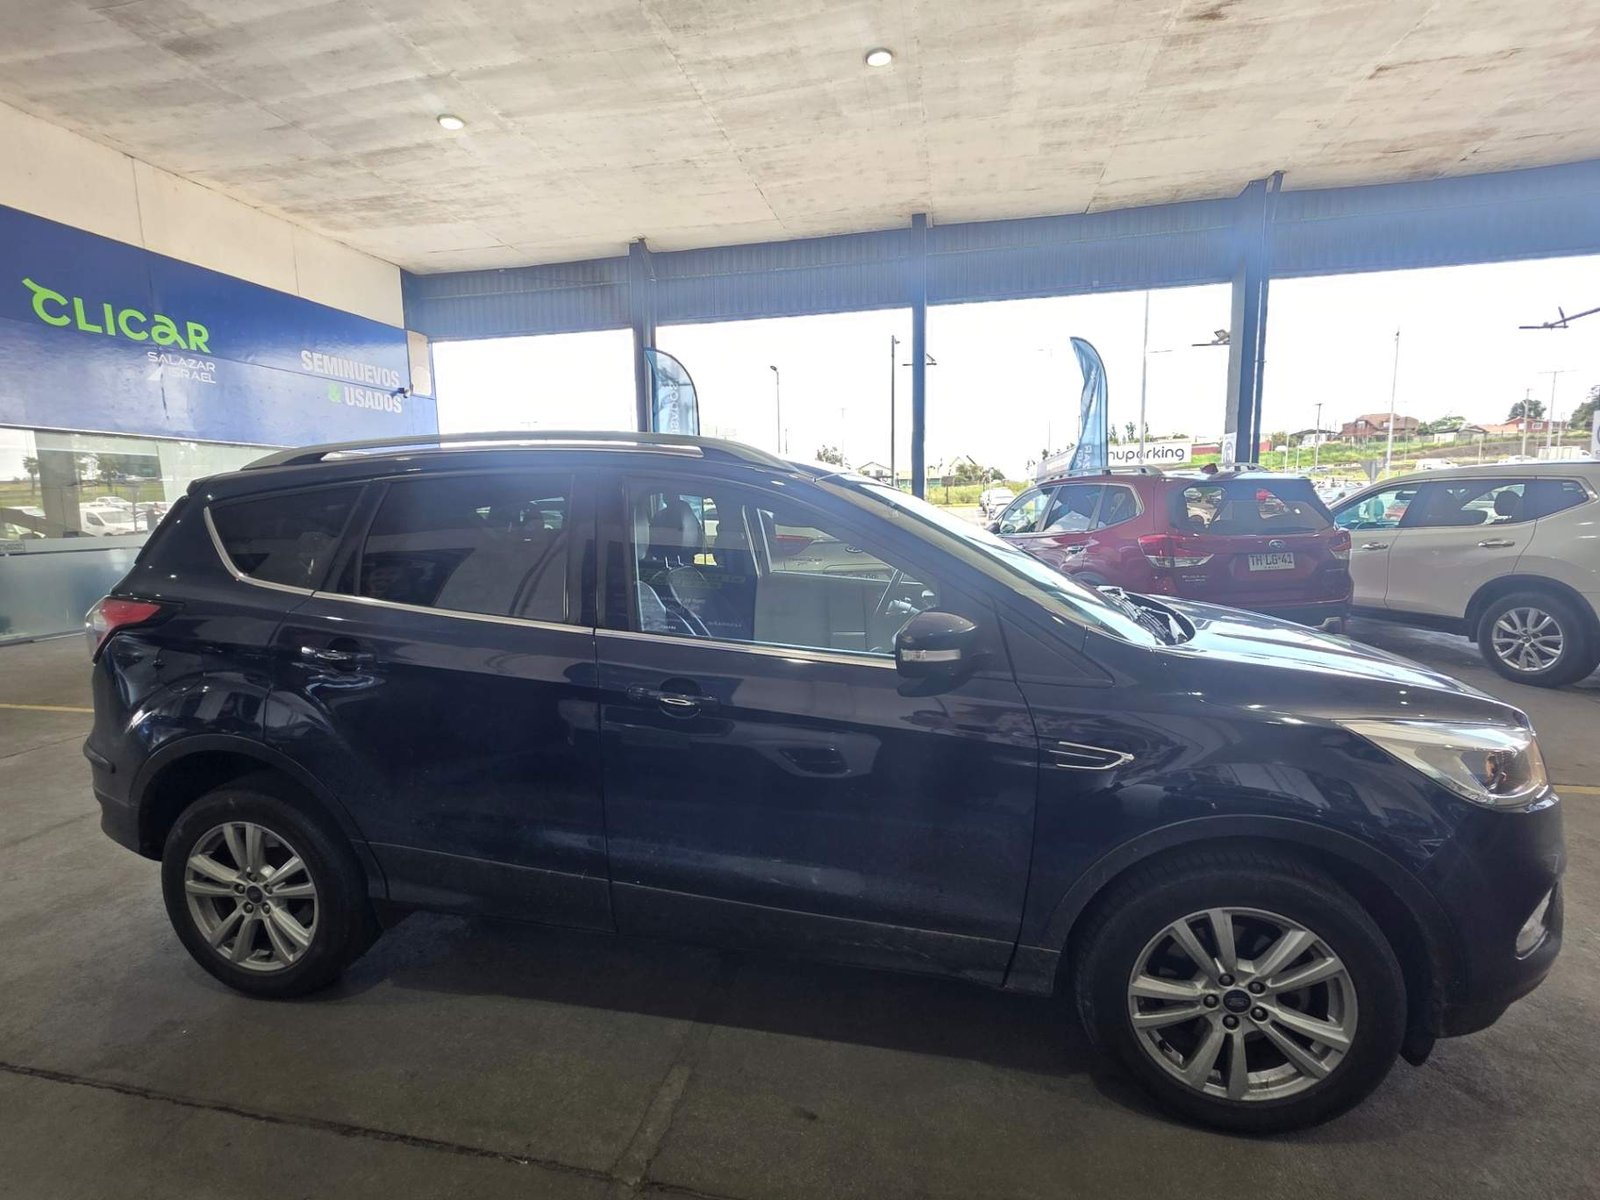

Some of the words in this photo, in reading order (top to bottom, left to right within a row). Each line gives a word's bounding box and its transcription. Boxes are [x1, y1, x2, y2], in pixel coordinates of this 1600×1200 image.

[147, 351, 216, 372] SALAZAR
[301, 350, 401, 388] SEMINUEVOS
[344, 386, 402, 414] USADOS
